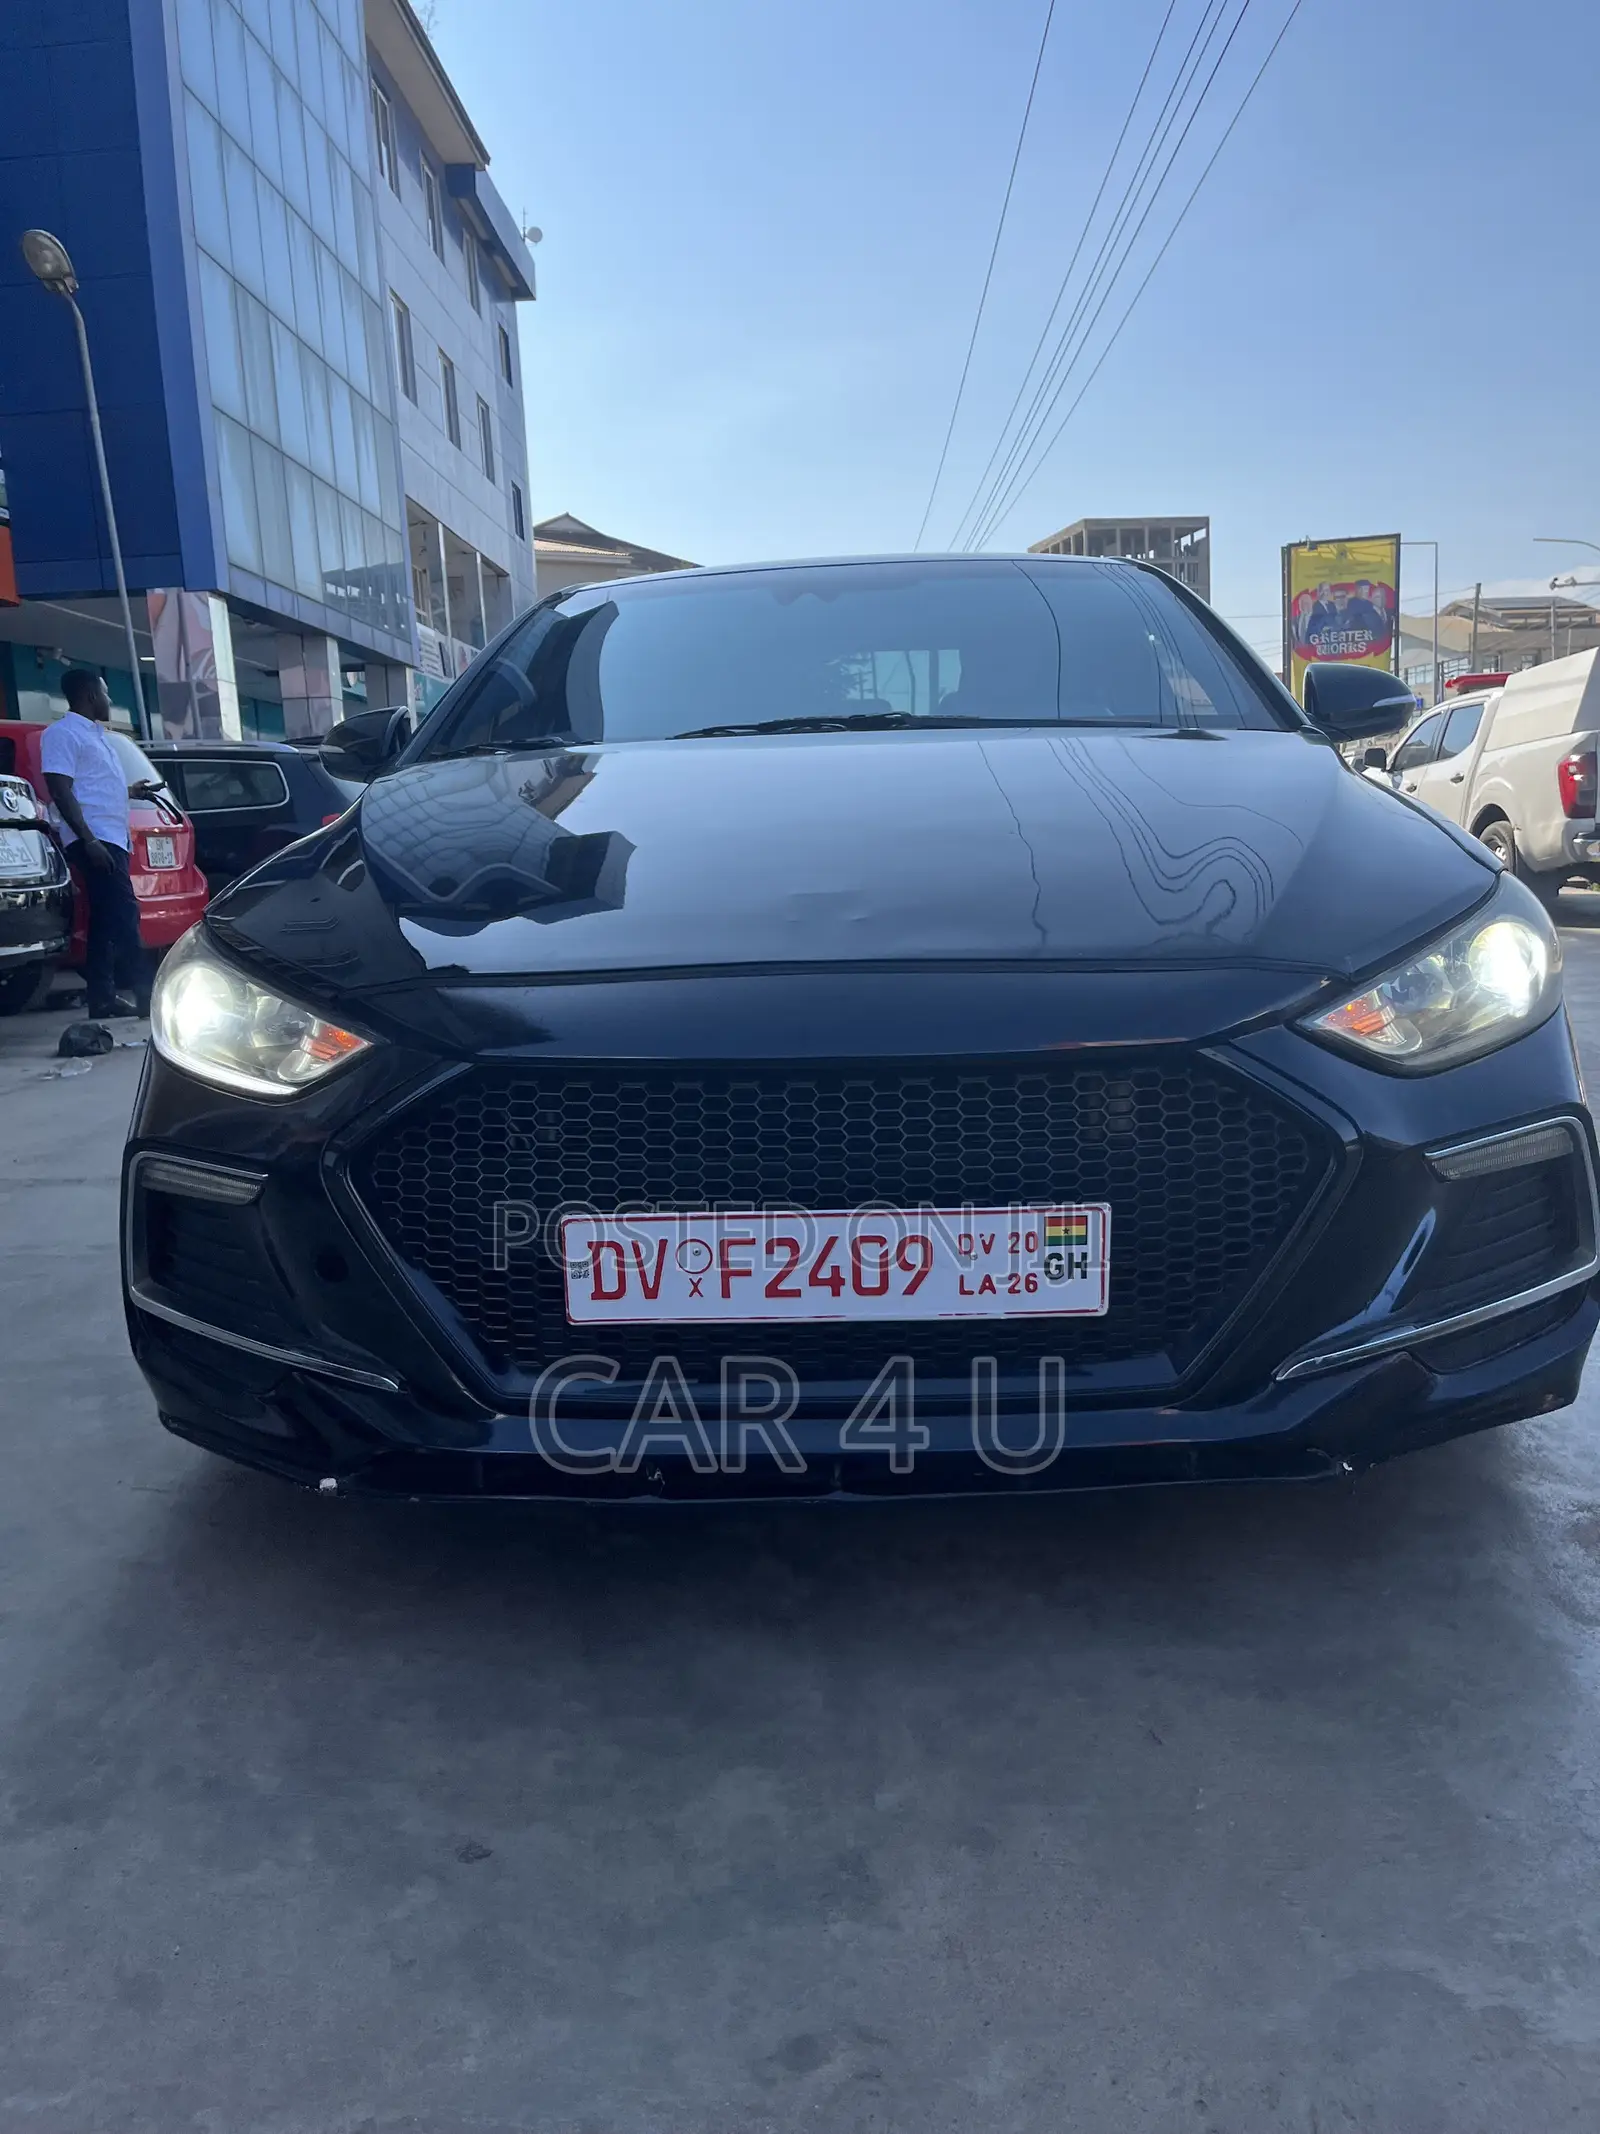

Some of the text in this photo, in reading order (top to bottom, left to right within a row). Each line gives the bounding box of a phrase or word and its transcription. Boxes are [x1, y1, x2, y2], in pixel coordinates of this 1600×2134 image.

[1309, 629, 1373, 645] GREATER
[1316, 641, 1367, 656] WORKS
[957, 1231, 1039, 1255] DV 20
[587, 1234, 935, 1301] DV F2409
[1043, 1252, 1088, 1281] GH
[958, 1272, 1039, 1296] LA 26
